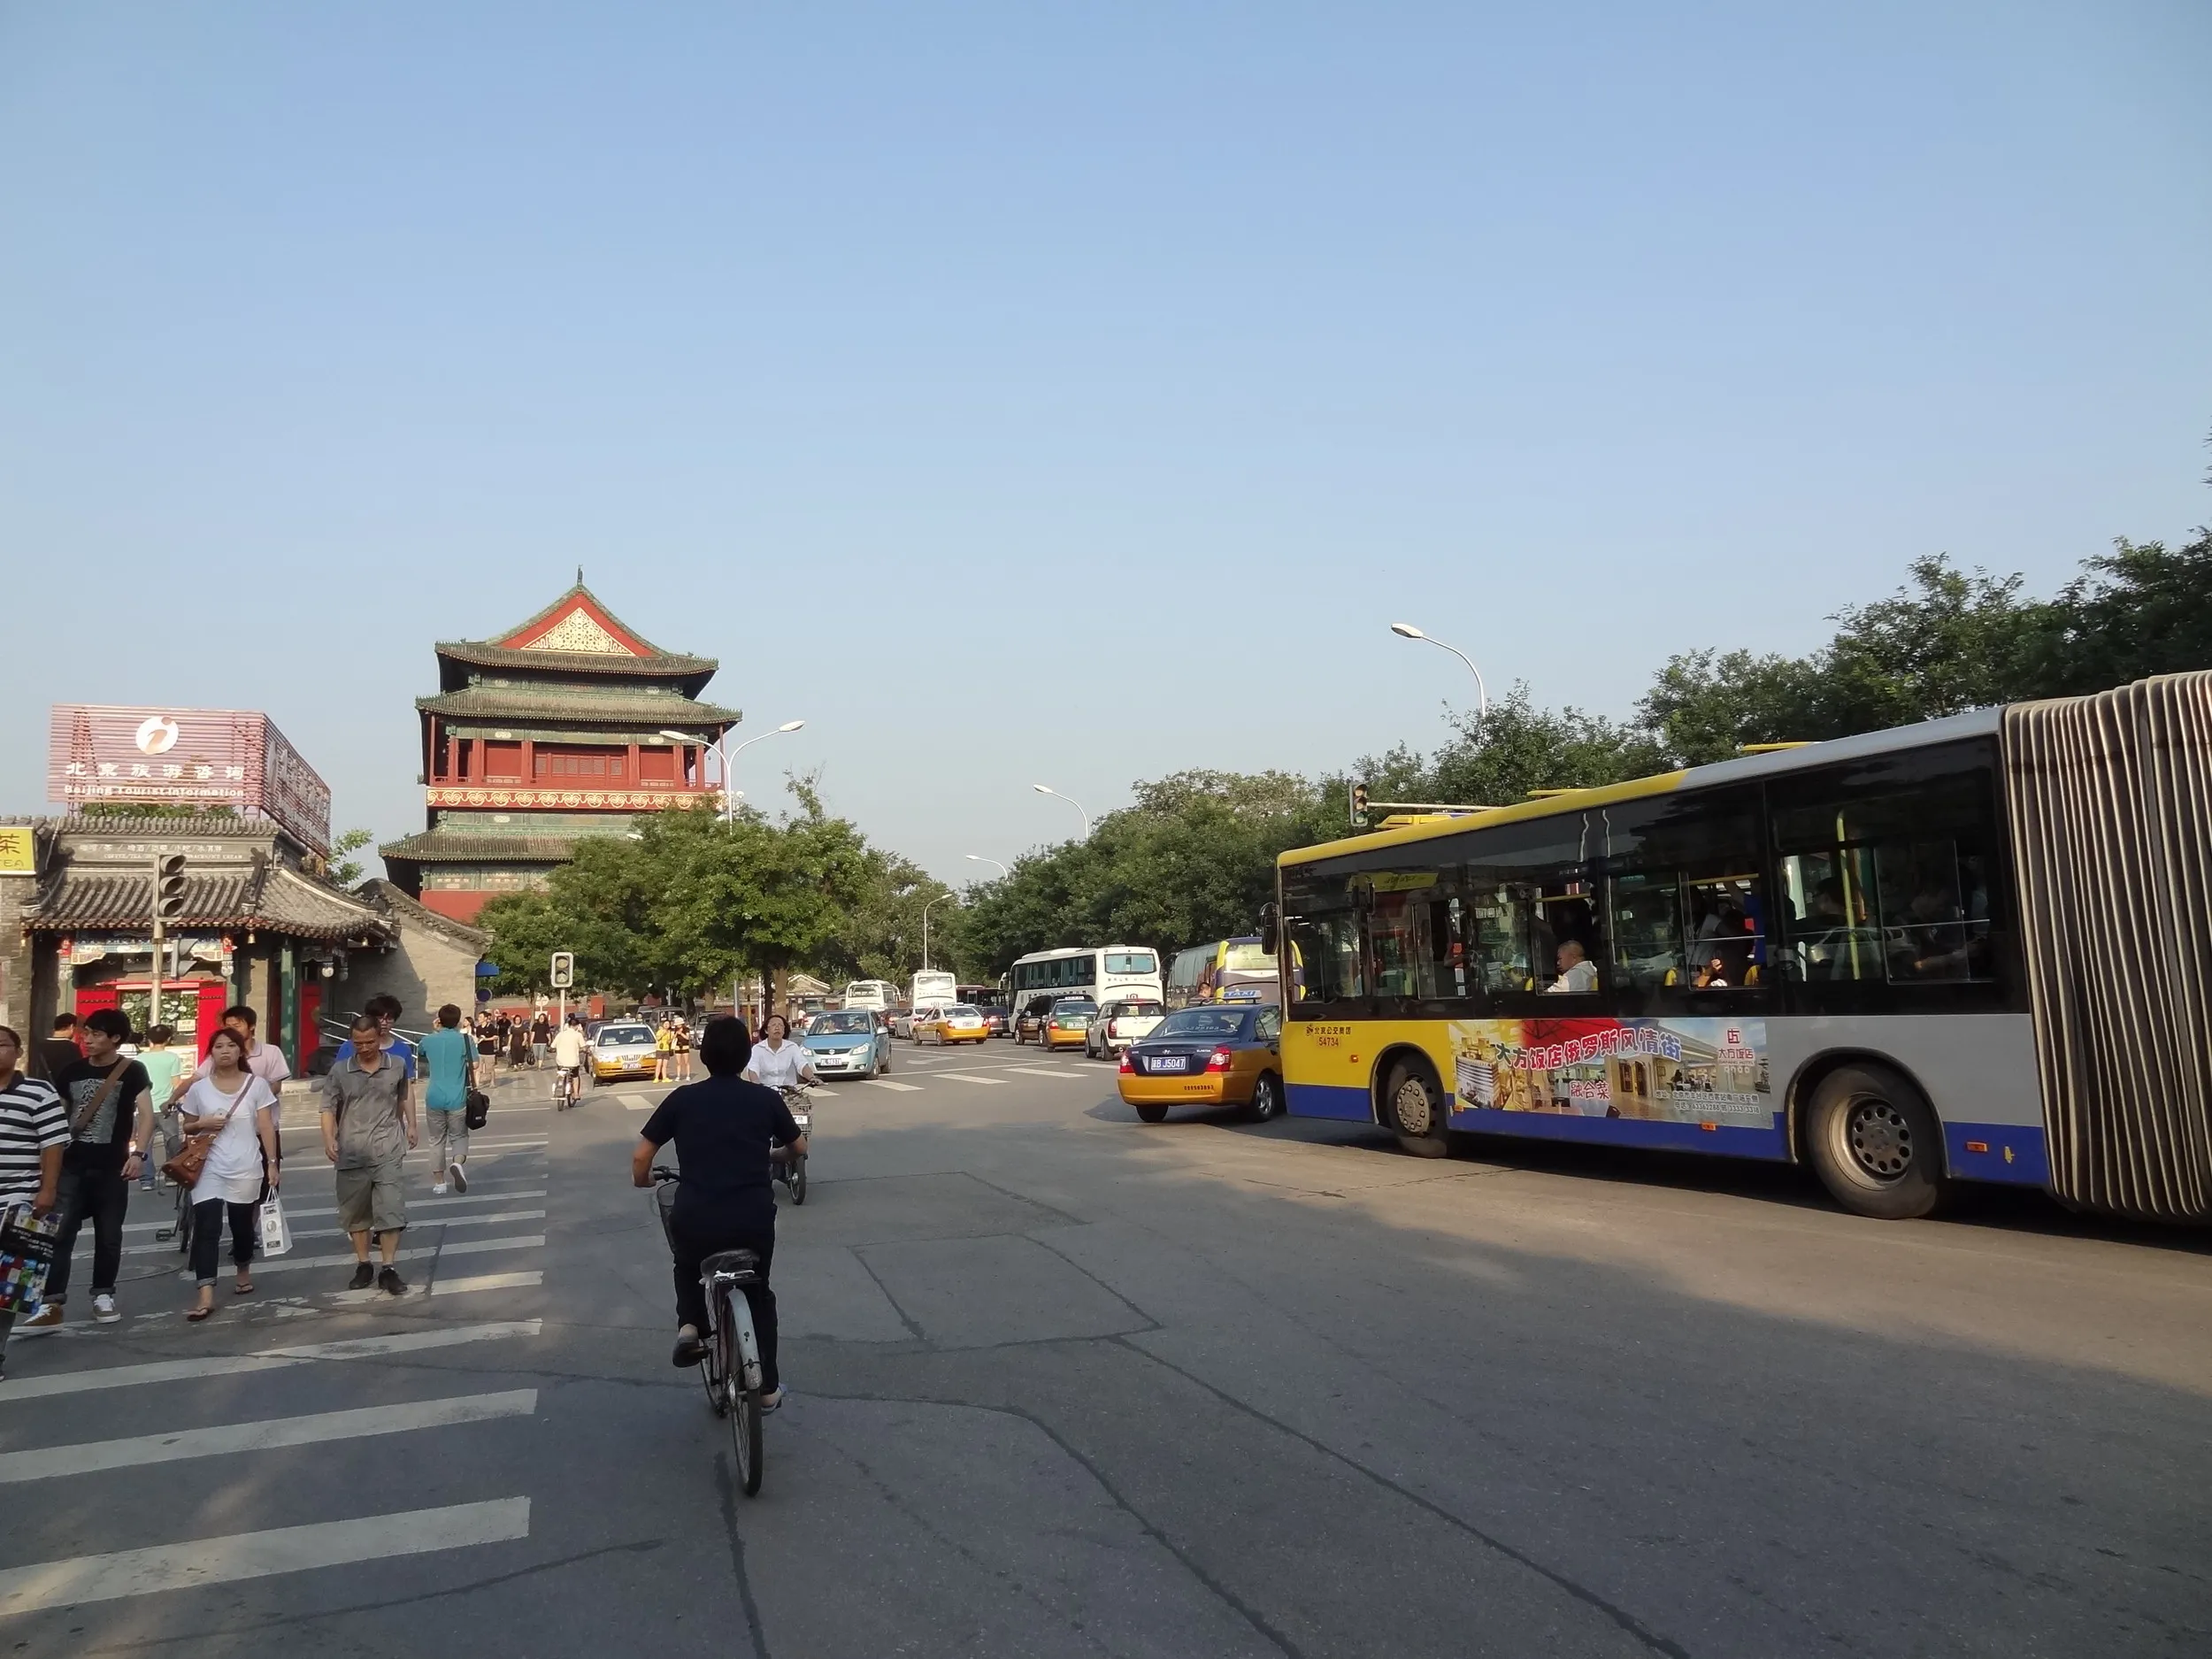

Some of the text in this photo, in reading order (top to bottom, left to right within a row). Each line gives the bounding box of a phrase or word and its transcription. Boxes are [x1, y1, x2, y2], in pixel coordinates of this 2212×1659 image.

[65, 762, 244, 780] 北京旅游咨询
[65, 785, 244, 797] Beijing Tourist Information
[1315, 1026, 1351, 1035] 北京公交集团
[1319, 1037, 1339, 1046] 54734
[1495, 1028, 1681, 1070] 大方饭店俄罗斯风情街
[1718, 1048, 1754, 1059] 大方饭店
[1570, 1080, 1611, 1100] 融合菜
